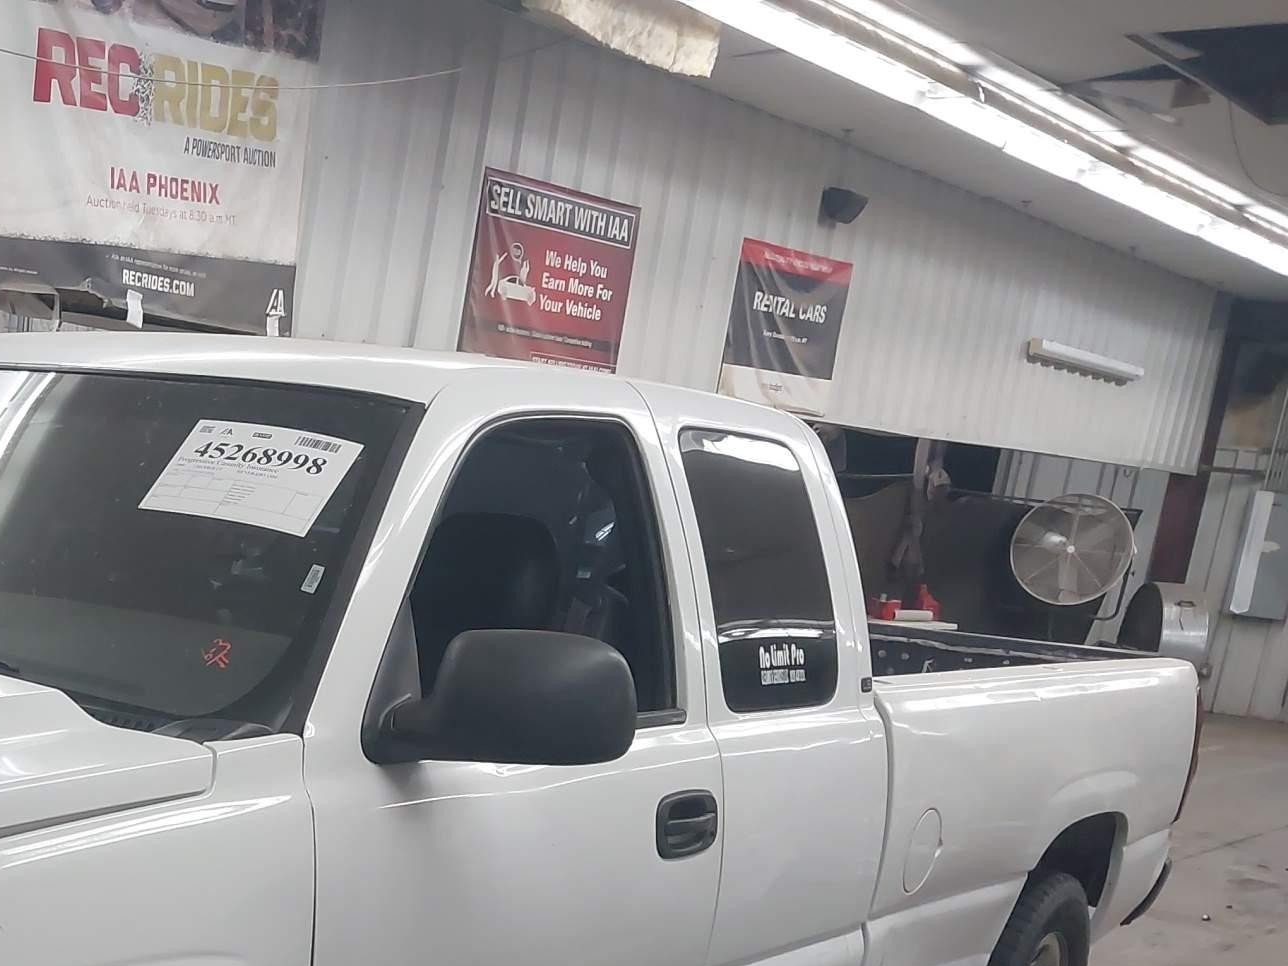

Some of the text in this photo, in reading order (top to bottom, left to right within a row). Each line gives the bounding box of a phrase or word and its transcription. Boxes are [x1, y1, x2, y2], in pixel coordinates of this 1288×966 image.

[33, 27, 280, 142] REC RIDES
[184, 136, 277, 169] A POWERSPORT AUCTION
[110, 166, 221, 206] IAA PHOENIX
[490, 184, 630, 242] SELL SMART WITH IAA
[545, 249, 562, 269] We
[563, 254, 587, 277] Help
[590, 259, 608, 279] You
[122, 268, 195, 297] RECRIDES.COM
[541, 272, 613, 301] Earn More For
[539, 294, 602, 321] Your Vehicle
[753, 291, 828, 324] RENTAL CARS
[194, 441, 327, 475] 45268998
[791, 643, 805, 666] Pro
